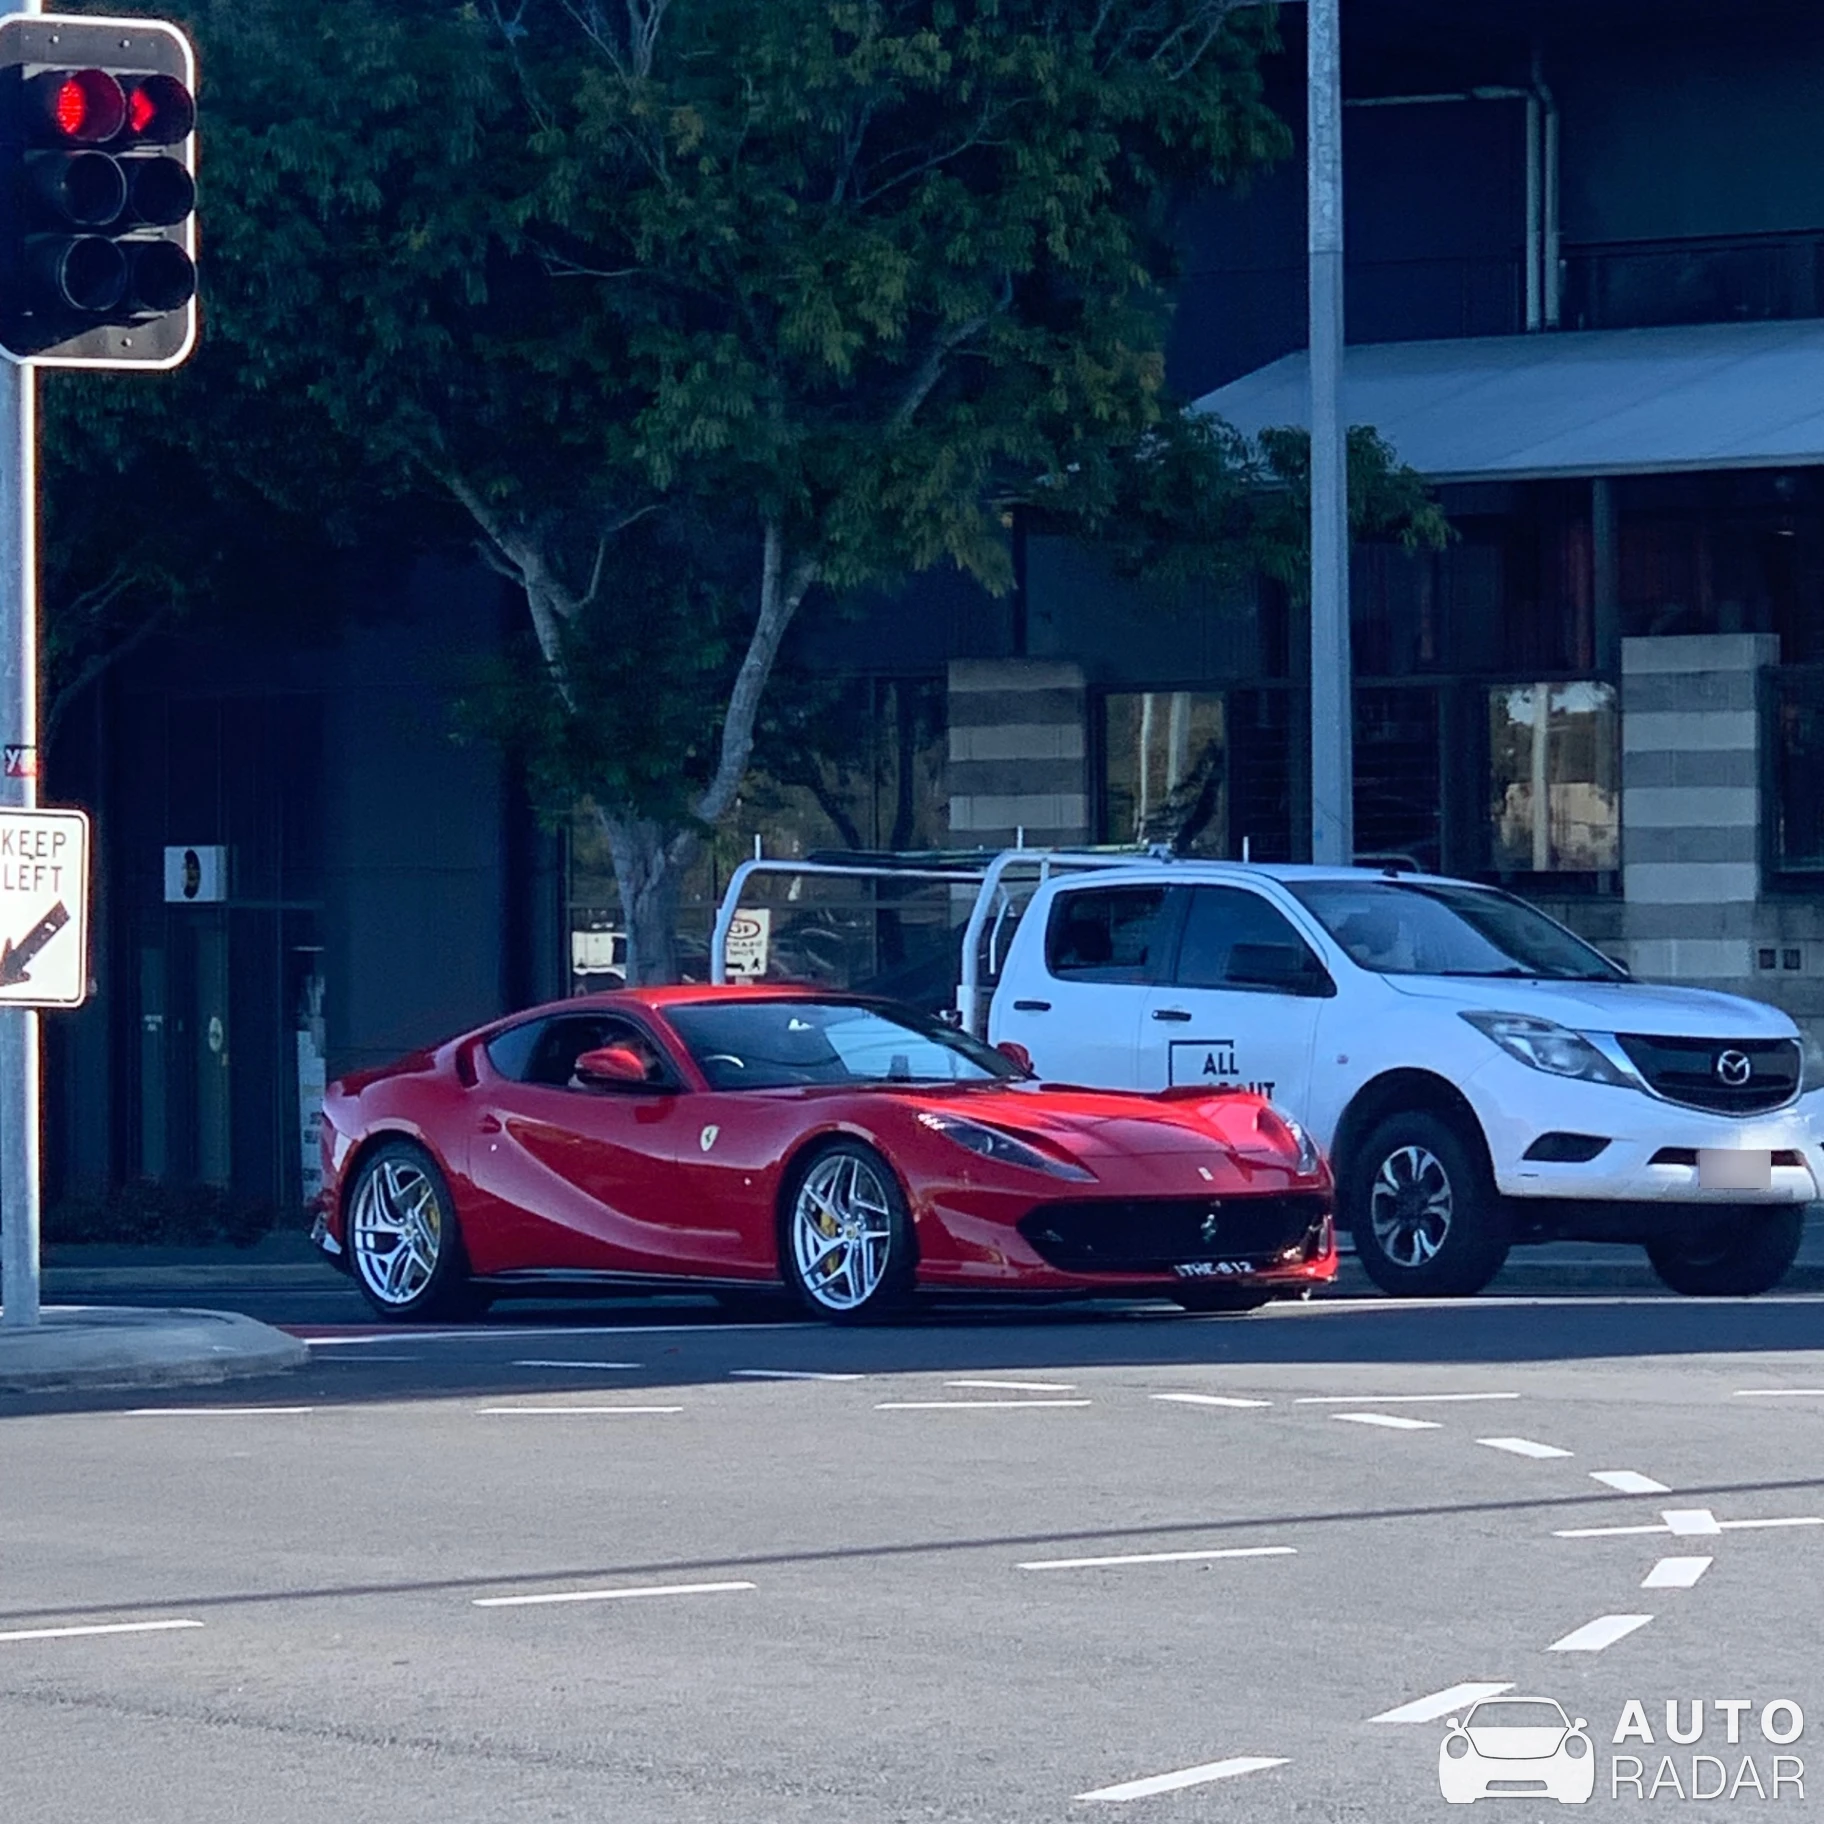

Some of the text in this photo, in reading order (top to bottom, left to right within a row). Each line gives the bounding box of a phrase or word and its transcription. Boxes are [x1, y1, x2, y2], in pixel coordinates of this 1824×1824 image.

[2, 829, 67, 858] KEEP
[4, 865, 63, 892] LEFT
[1203, 1052, 1239, 1075] ALL
